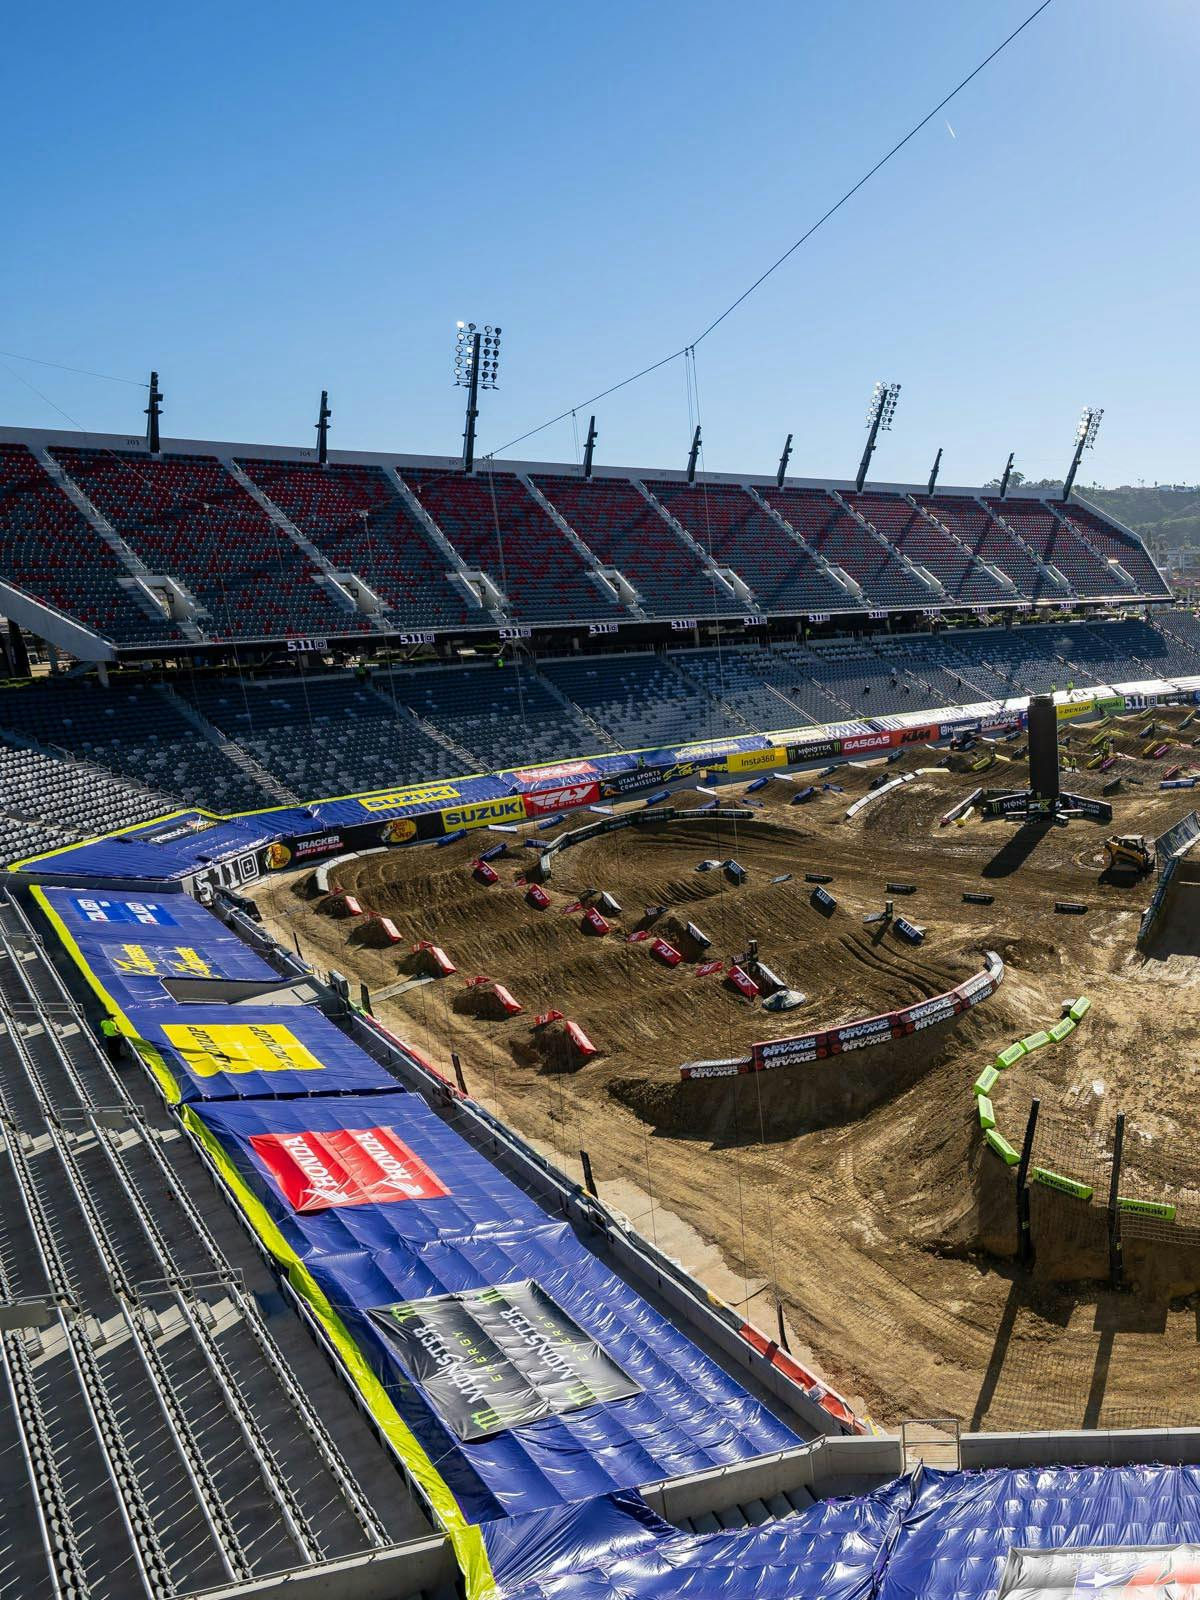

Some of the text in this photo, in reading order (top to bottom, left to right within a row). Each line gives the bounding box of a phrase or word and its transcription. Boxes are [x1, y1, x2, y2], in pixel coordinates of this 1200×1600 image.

[1064, 704, 1091, 714] DUNLOP
[844, 736, 891, 750] GASGAS
[901, 729, 932, 743] KTM
[741, 754, 775, 767] Insta360
[618, 770, 661, 785] UTAH SPORTS
[620, 776, 662, 791] COMMISSION
[366, 789, 454, 809] SUZUKI
[526, 784, 595, 806] FLY
[445, 801, 523, 825] SUZUKI
[297, 835, 340, 850] TRACKER
[657, 945, 673, 958] FLY
[734, 973, 751, 987] FLY
[284, 1135, 340, 1188] HONDA
[355, 1131, 413, 1180] HONDA
[1038, 1172, 1080, 1195] Kawasaki
[499, 1305, 577, 1380] MONSTER
[535, 1314, 588, 1362] ENERGY
[412, 1323, 486, 1404] MONSTER
[453, 1331, 503, 1383] ENERGY
